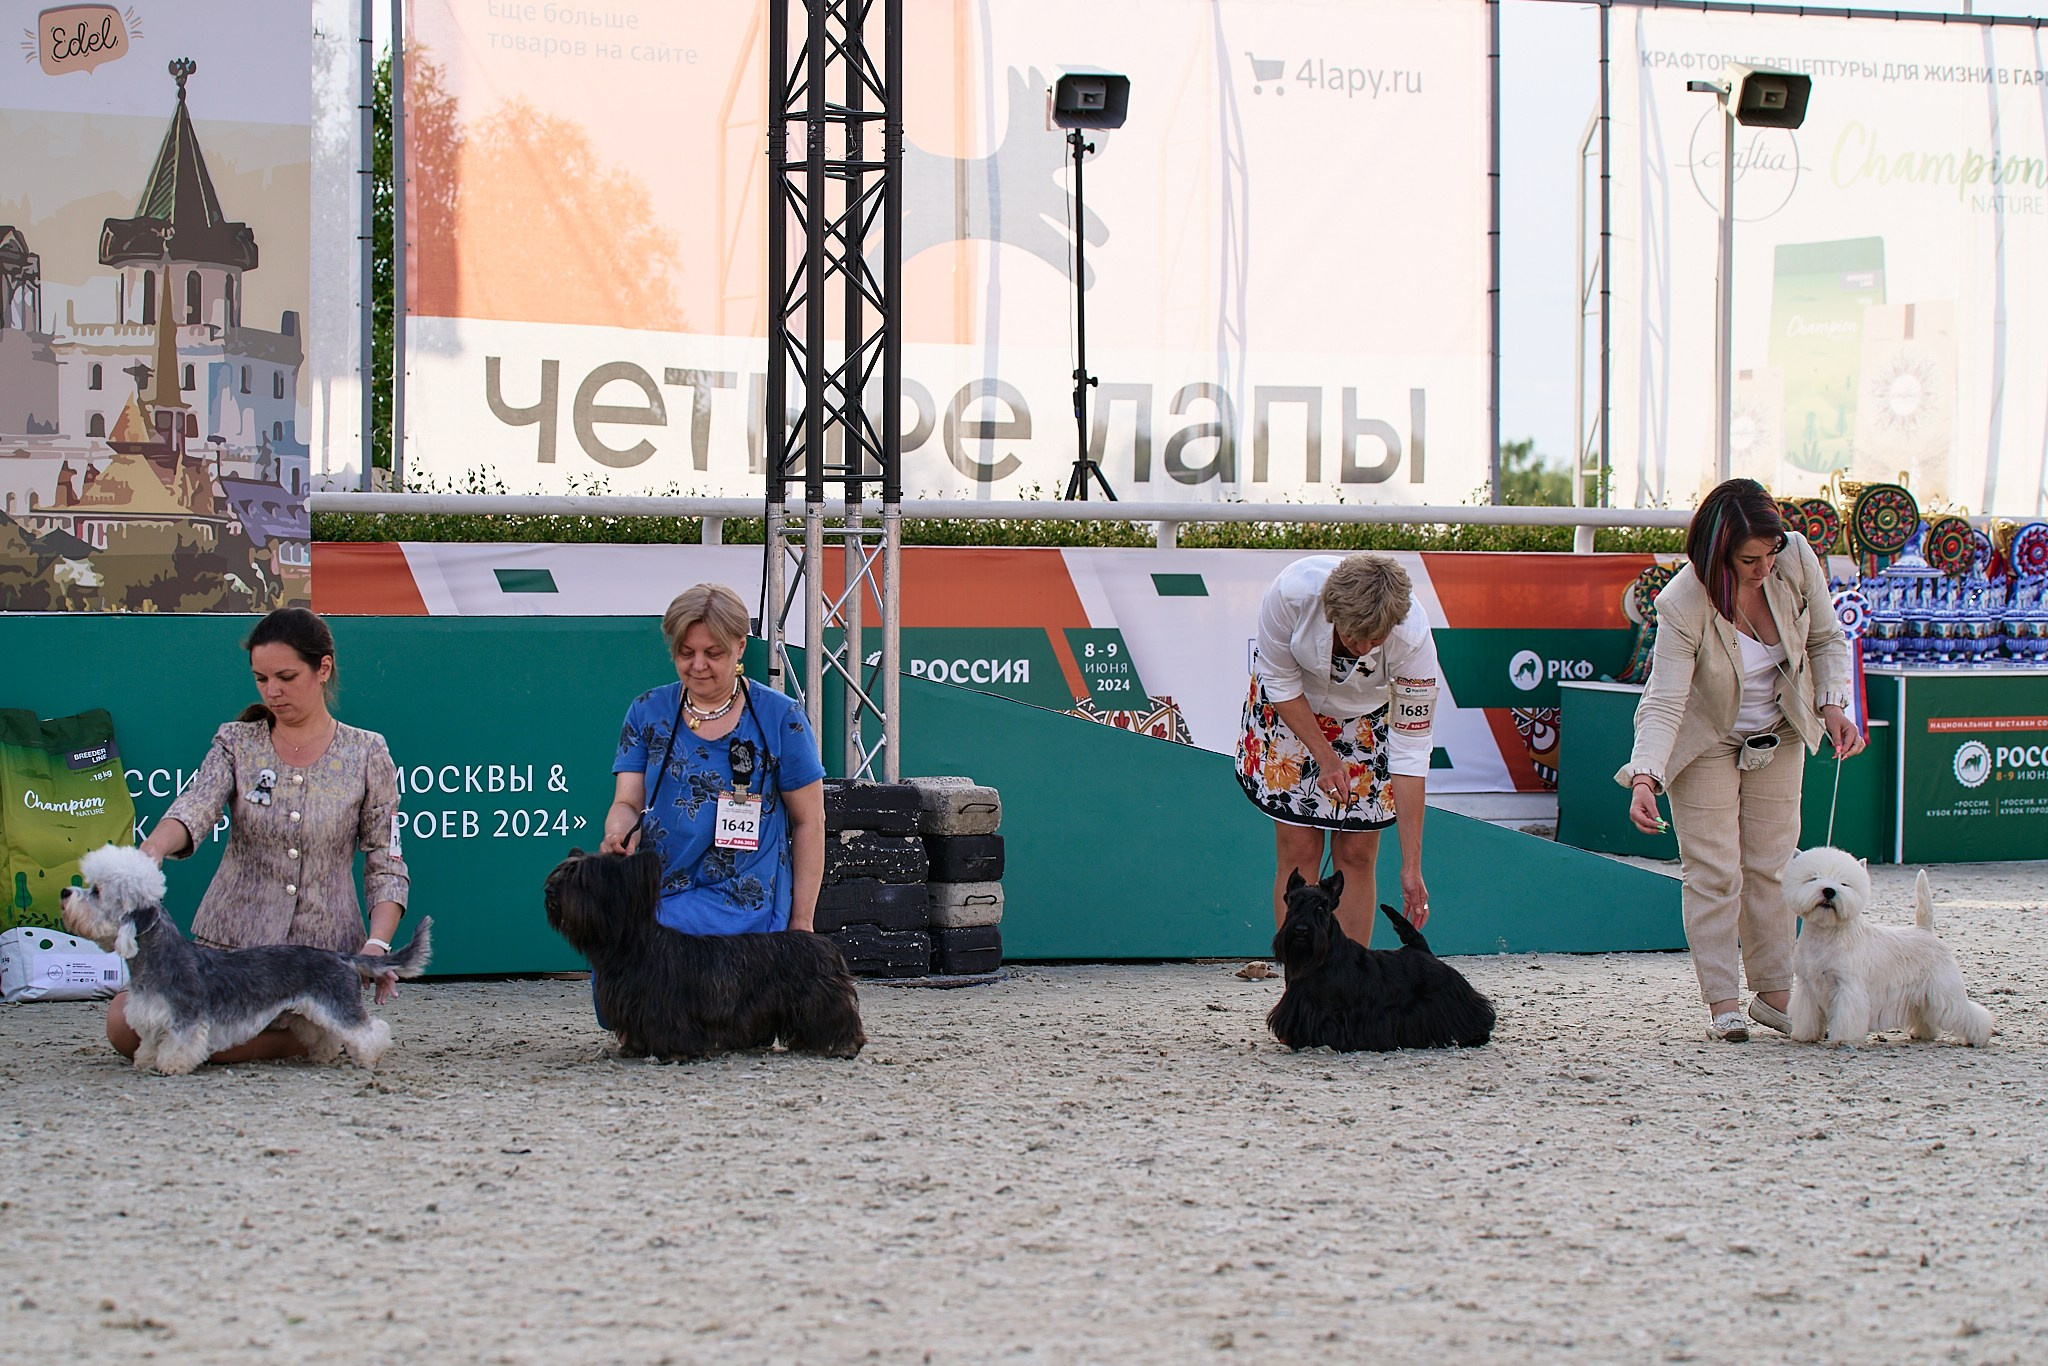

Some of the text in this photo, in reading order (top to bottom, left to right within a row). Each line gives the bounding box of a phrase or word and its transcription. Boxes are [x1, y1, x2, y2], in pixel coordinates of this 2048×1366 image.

[487, 0, 639, 30] Еще больше
[52, 16, 117, 60] Edel
[487, 32, 698, 65] товаров на сайте
[1295, 58, 1422, 99] 4lapy.ru
[1882, 63, 1919, 83] ДЛЯ
[1924, 64, 1994, 84] ЖИЗНИ
[1998, 68, 2009, 84] В
[2013, 69, 2048, 86] ГАР
[1830, 120, 2048, 202] Champion
[1972, 195, 2045, 214] NATURE
[1086, 381, 1426, 485] лапы
[910, 658, 1030, 684] РОССИЯ
[1085, 662, 1128, 674] ИЮНЯ
[1547, 659, 1594, 680] РКФ
[1097, 679, 1131, 692] 2024
[1399, 704, 1429, 717] 1683
[1930, 721, 1993, 729] НАЦИОНАЛЬНЫЕ
[1995, 720, 2035, 728] ВЫСТАВКИ
[73, 748, 107, 761] BREEDER
[92, 753, 108, 764] LINE
[547, 764, 569, 792] &
[2017, 769, 2048, 780] ИЮН
[24, 789, 106, 815] Champion
[75, 807, 105, 818] NATURE
[493, 809, 588, 837] 2024»
[721, 818, 754, 833] 1642
